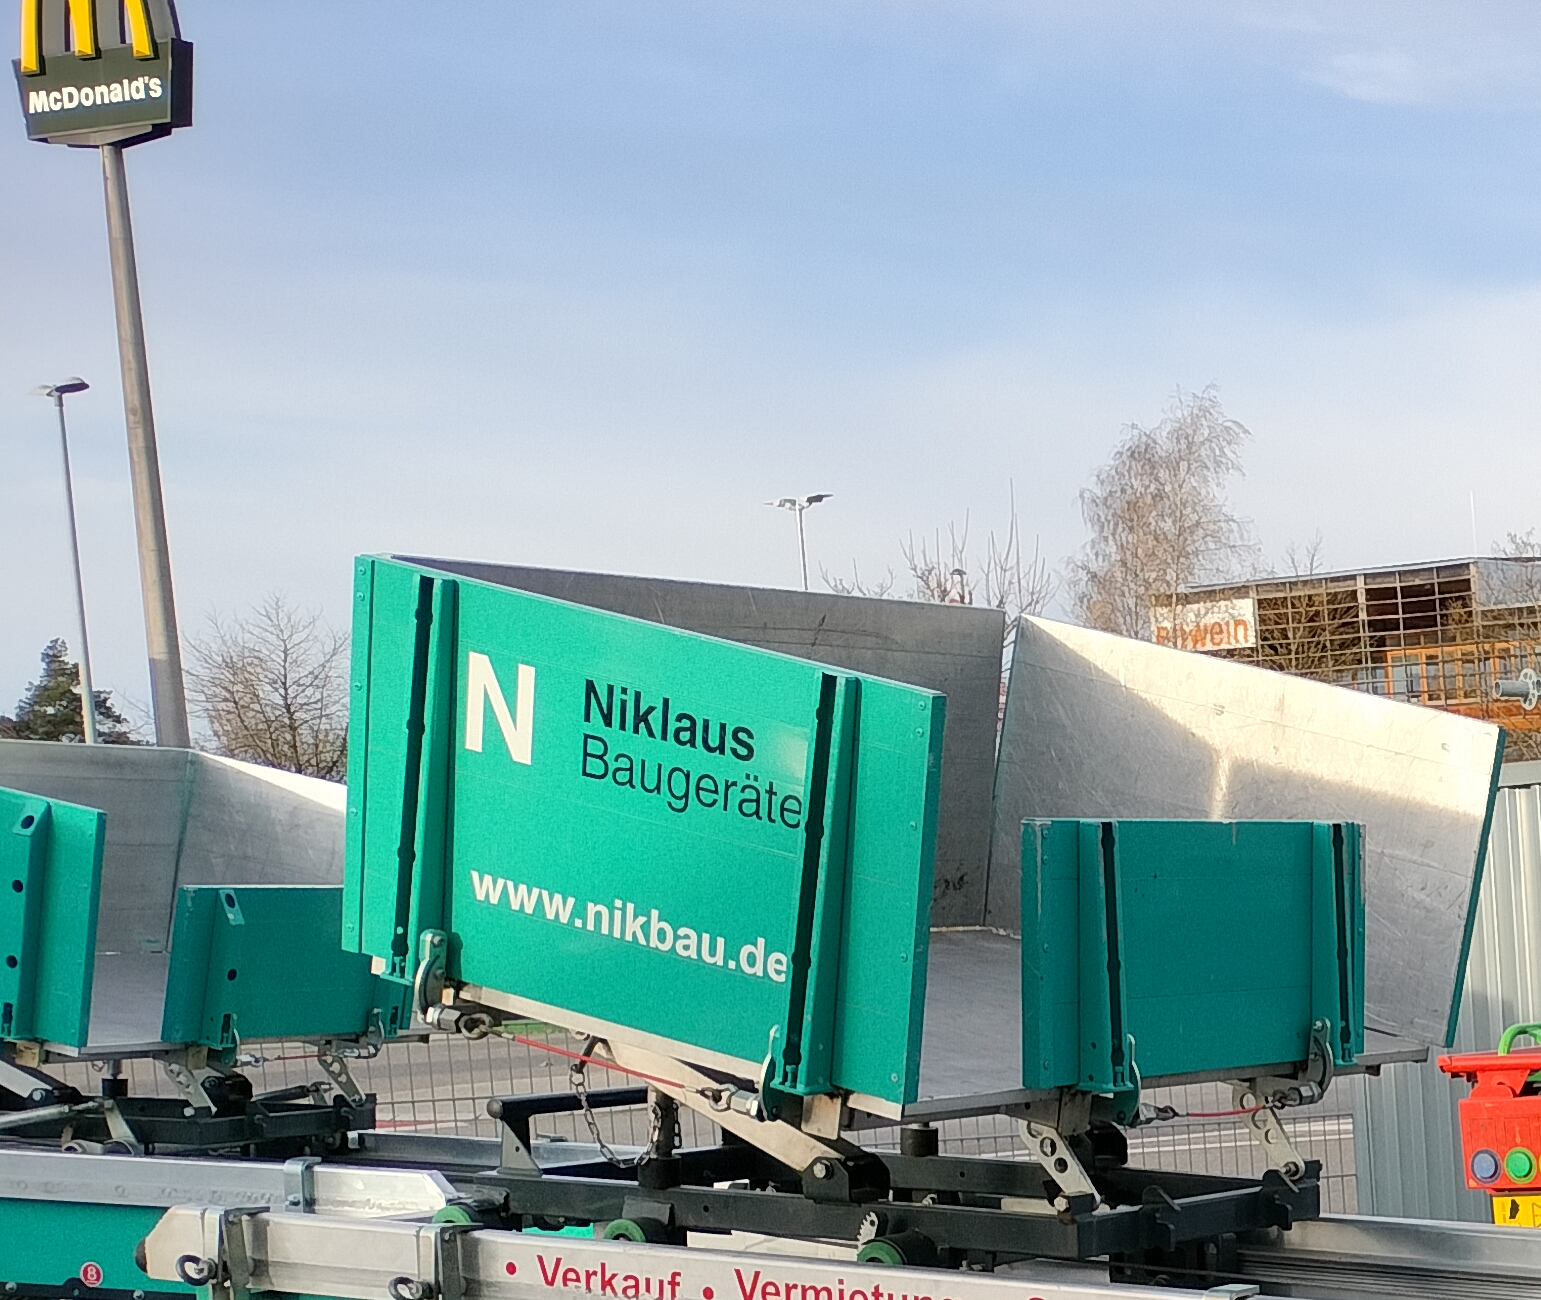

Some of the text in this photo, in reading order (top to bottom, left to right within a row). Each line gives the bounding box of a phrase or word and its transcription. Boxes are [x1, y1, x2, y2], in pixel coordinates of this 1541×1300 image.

[29, 76, 162, 114] McDonald's
[465, 651, 536, 766] N
[582, 678, 756, 762] Niklaus
[581, 734, 802, 830] Baugeräte
[471, 870, 787, 984] www.nikbau.de
[87, 1265, 98, 1281] 8
